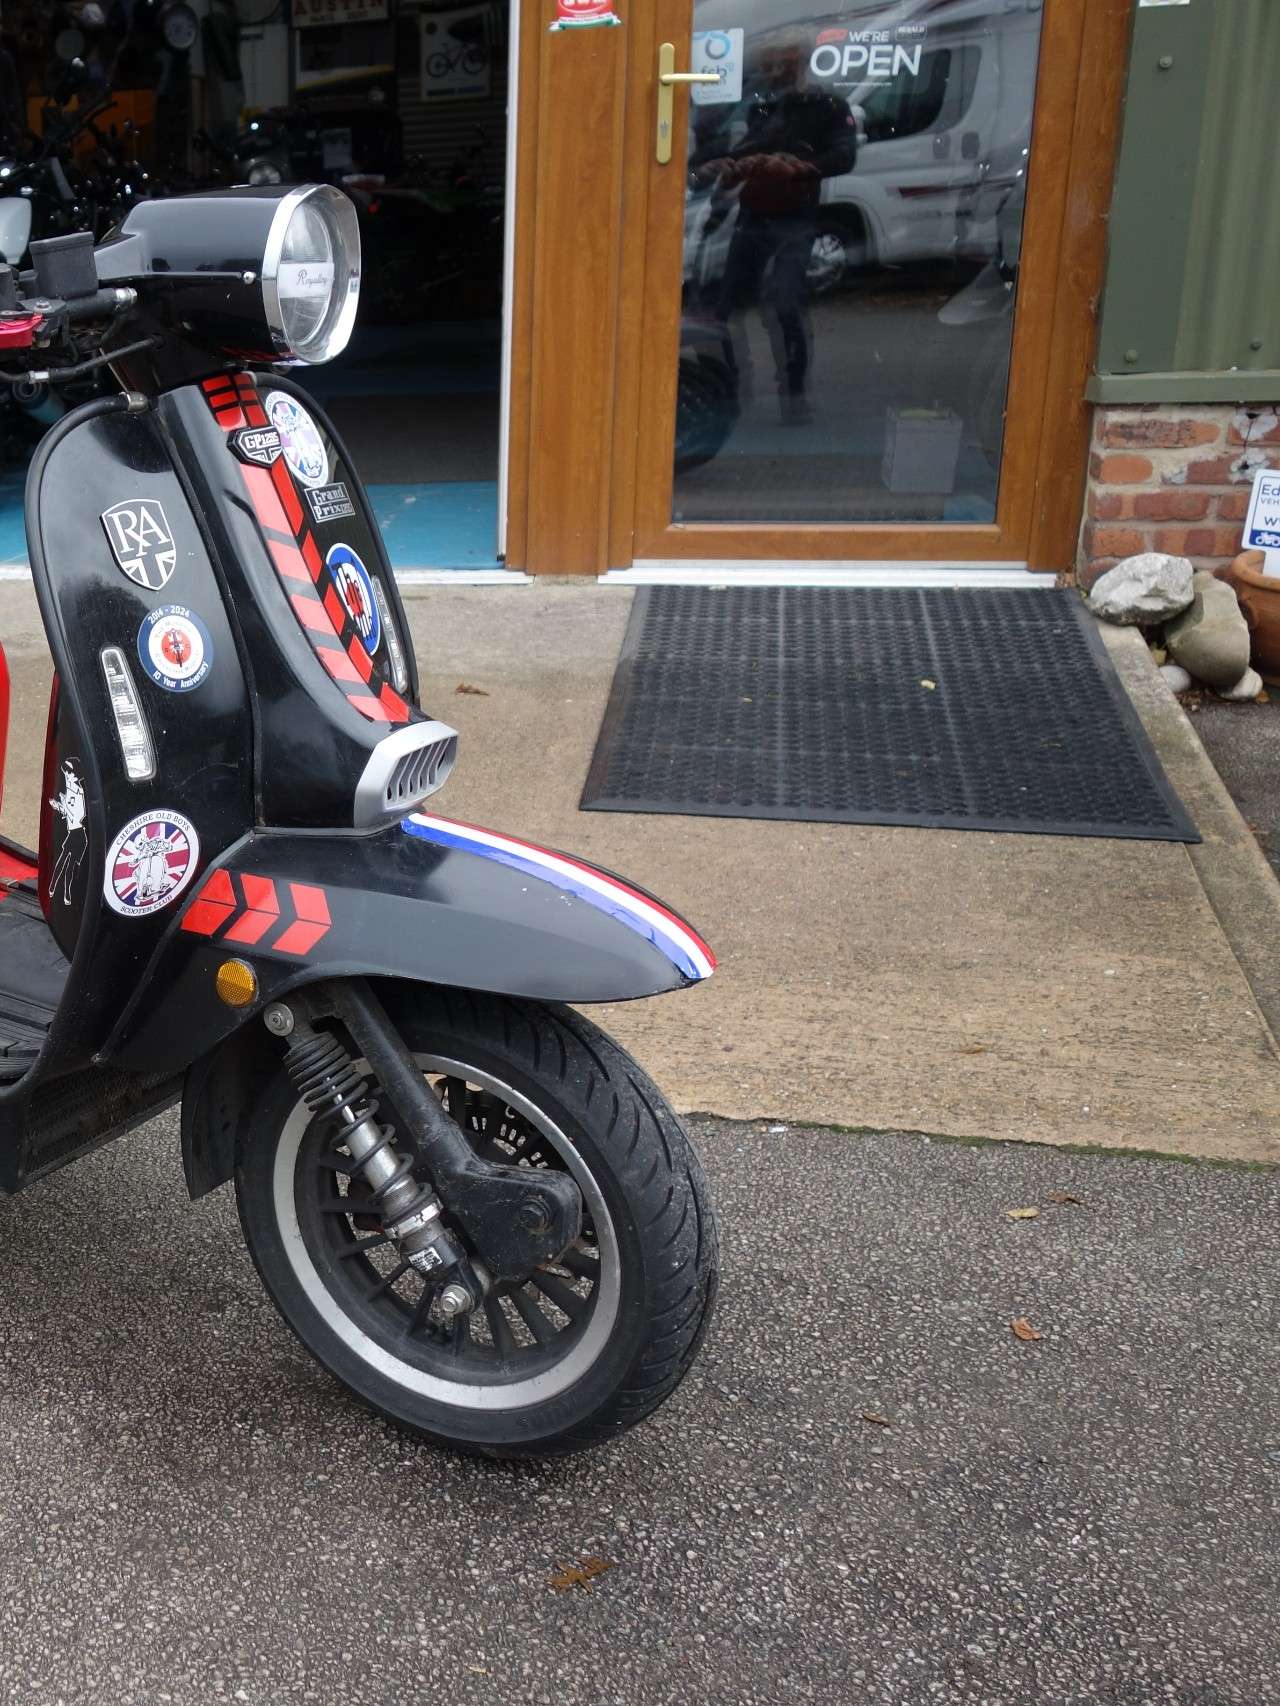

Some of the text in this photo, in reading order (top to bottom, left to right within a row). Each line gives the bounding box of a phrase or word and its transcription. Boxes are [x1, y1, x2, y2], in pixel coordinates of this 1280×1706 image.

[848, 31, 890, 42] WE'RE
[810, 44, 922, 76] OPEN
[312, 485, 346, 505] Grand
[313, 503, 341, 520] Prix
[147, 608, 164, 625] 2014
[163, 676, 178, 688] Year
[116, 812, 191, 846] CHESHIRE OLD BOYS
[120, 894, 173, 915] SCOOTER CLUB
